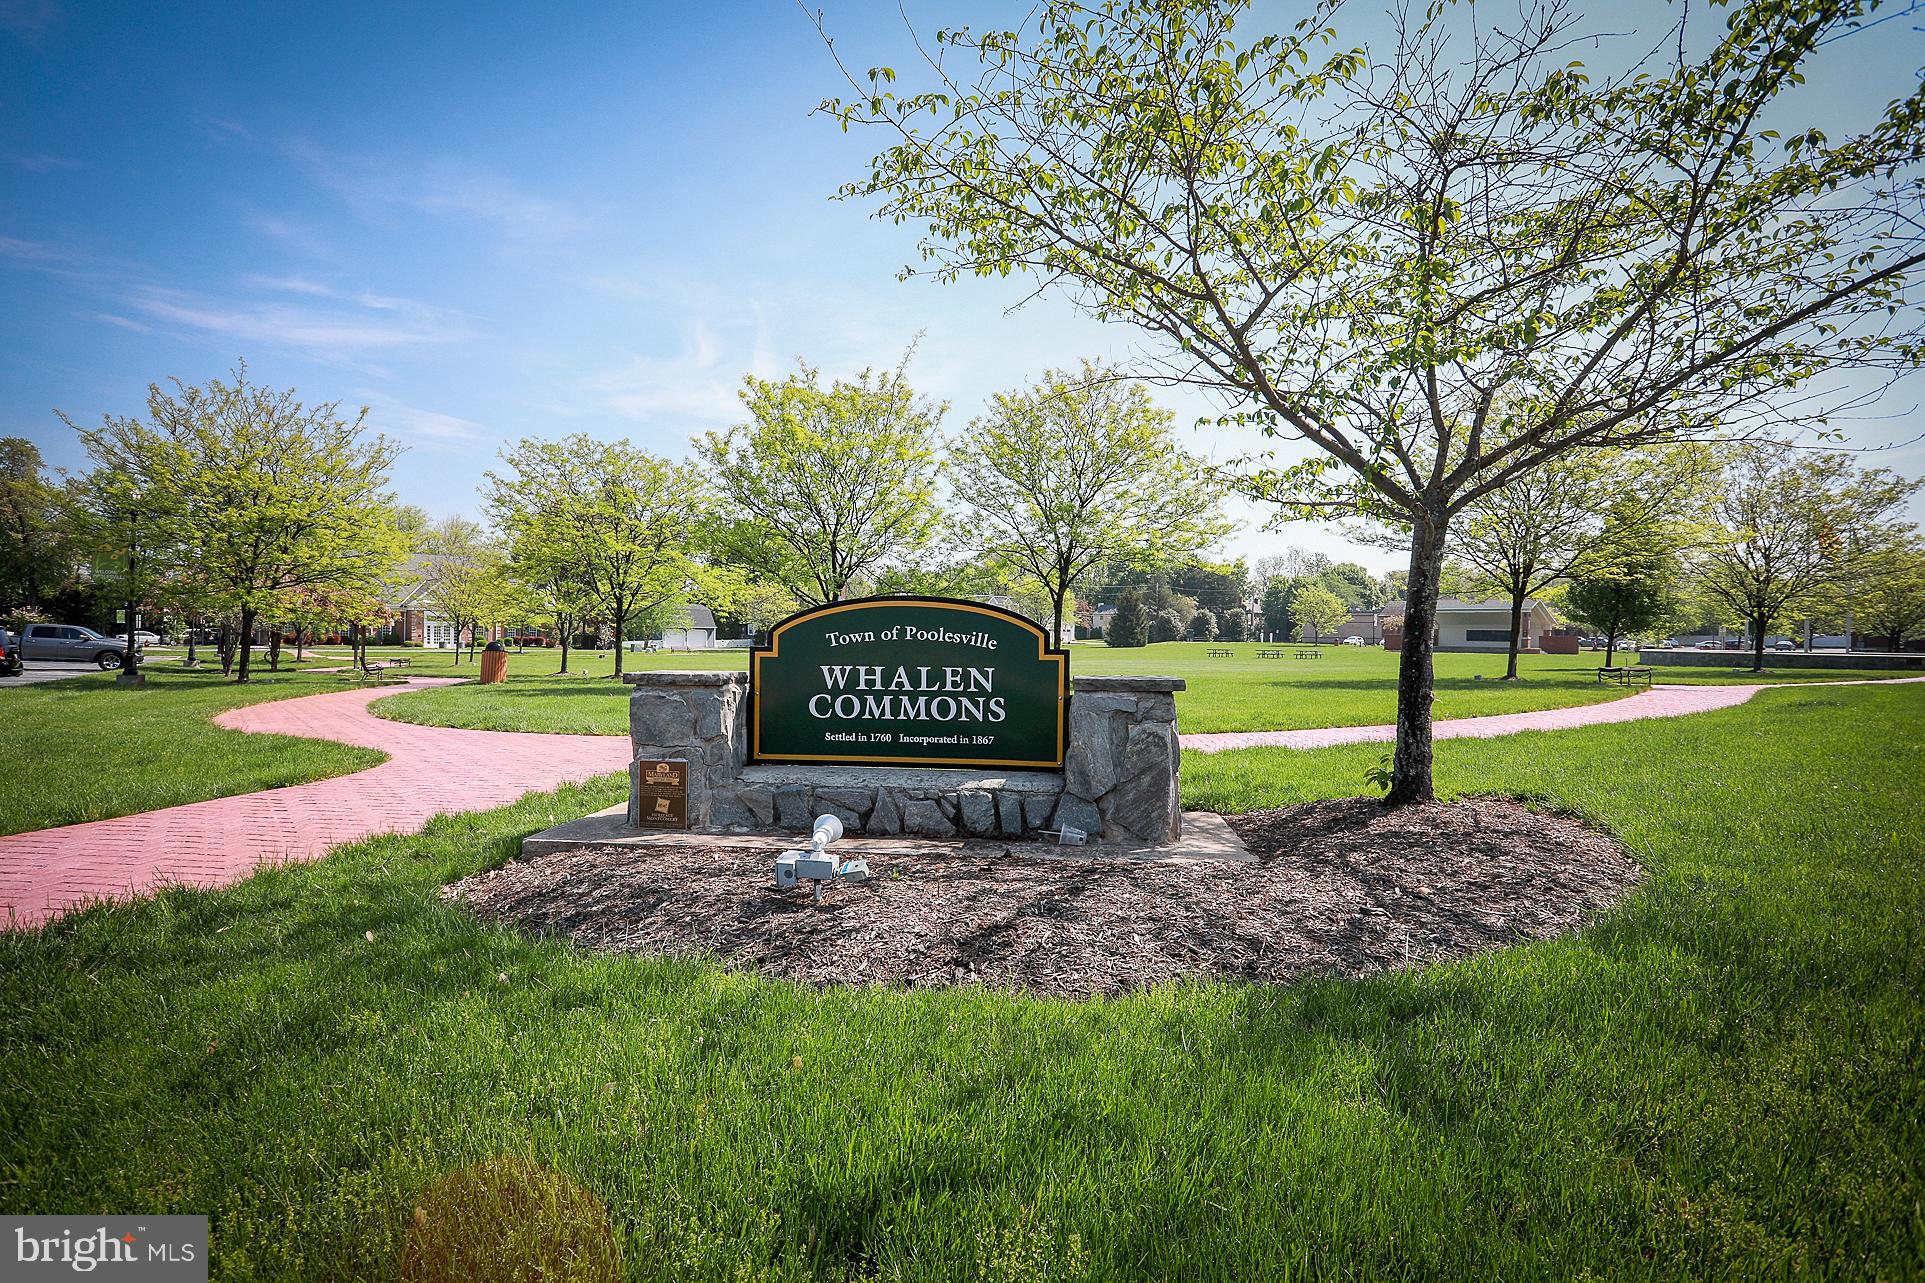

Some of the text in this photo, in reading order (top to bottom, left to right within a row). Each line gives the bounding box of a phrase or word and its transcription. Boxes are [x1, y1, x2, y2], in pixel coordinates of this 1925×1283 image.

[826, 626, 998, 650] Town of Poolesville
[820, 665, 995, 693] WHALEN
[808, 694, 1006, 722] COMMONS
[825, 732, 994, 746] Settled in 1760 Incorporated in 1867
